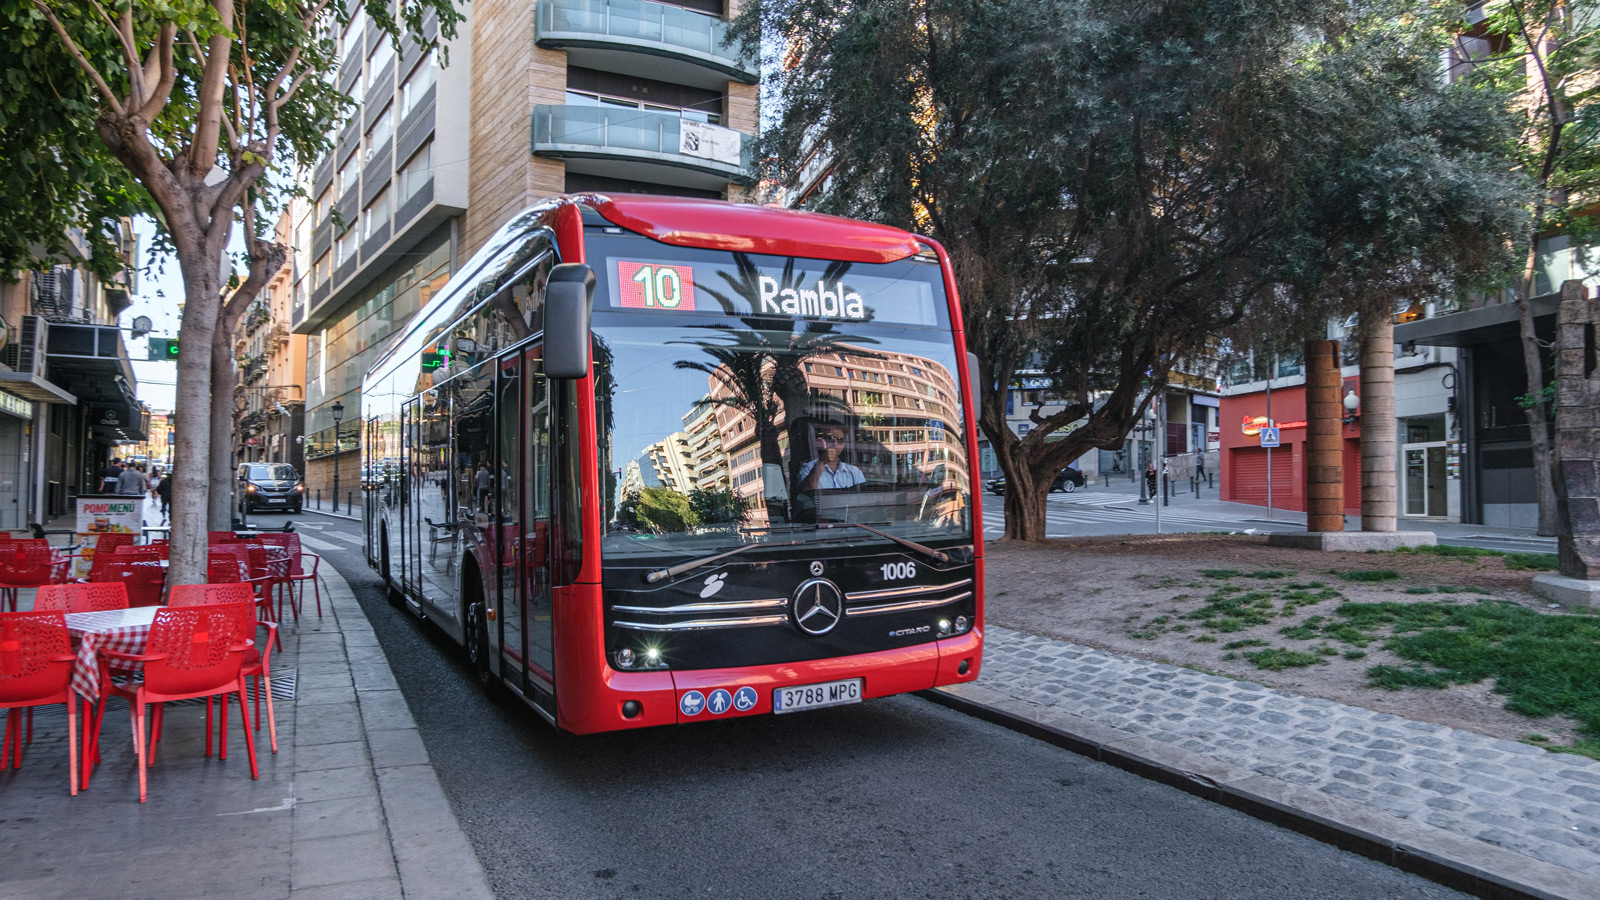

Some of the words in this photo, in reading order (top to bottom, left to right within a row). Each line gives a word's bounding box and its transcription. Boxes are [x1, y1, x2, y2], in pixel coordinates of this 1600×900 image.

[633, 265, 682, 308] 10
[758, 276, 865, 319] Rambla
[83, 501, 136, 513] POMOMENÚ
[880, 561, 916, 581] 1006
[785, 688, 824, 707] 3788
[829, 683, 857, 701] MPG
